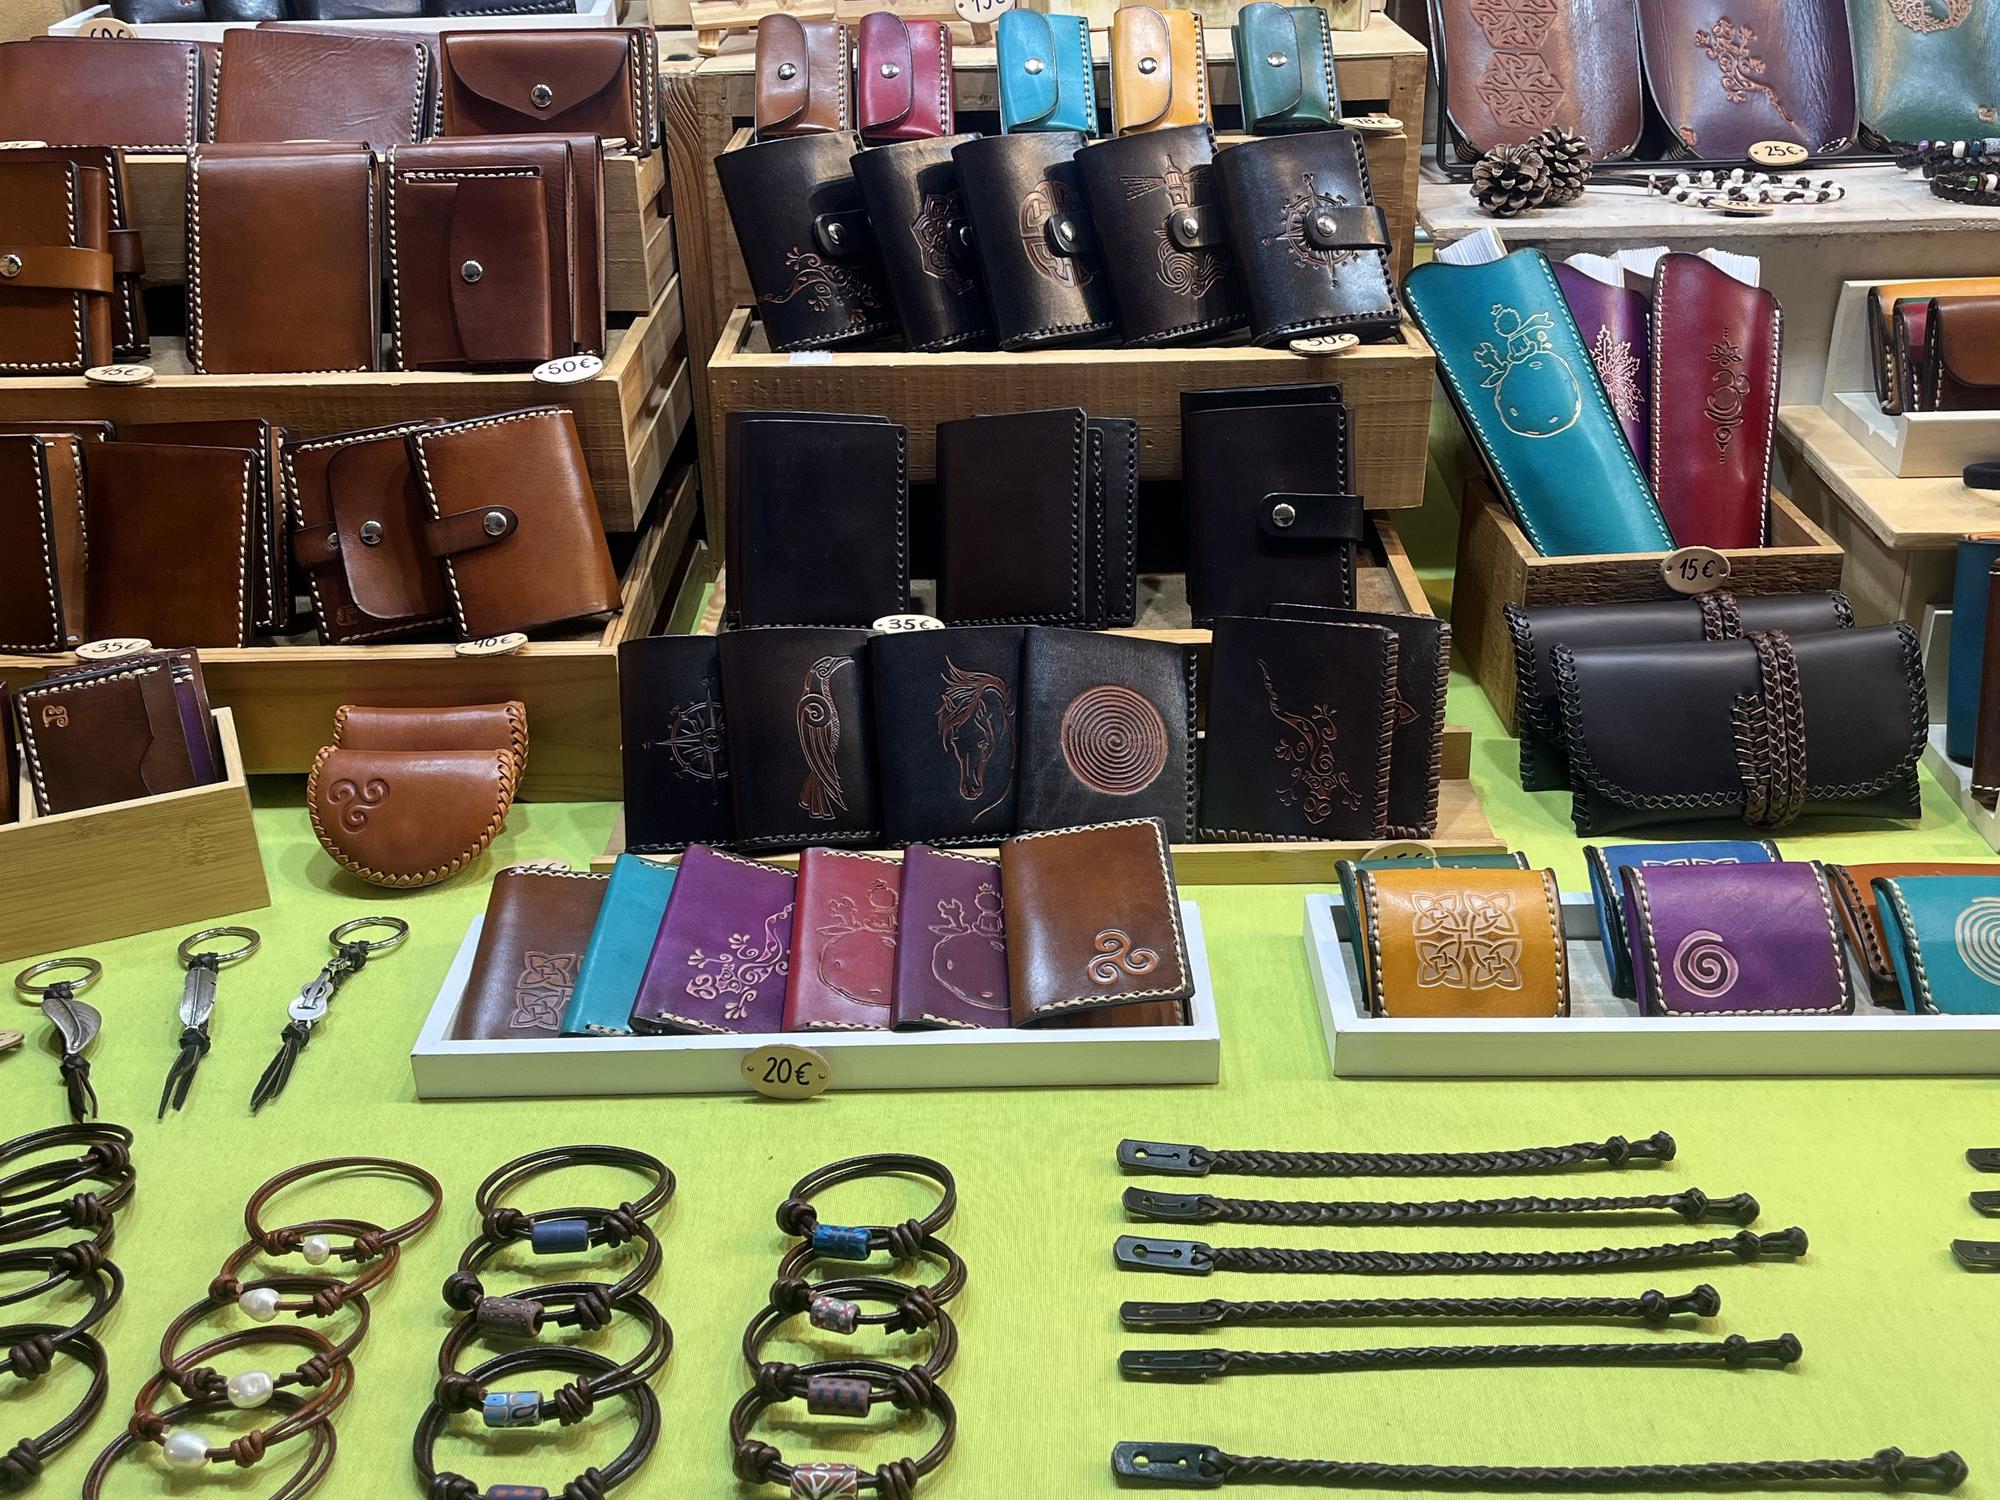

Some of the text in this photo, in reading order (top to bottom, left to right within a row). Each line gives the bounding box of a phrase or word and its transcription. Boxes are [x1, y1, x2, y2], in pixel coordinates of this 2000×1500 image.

[1764, 145, 1798, 157] 25€
[101, 366, 141, 376] 45€
[548, 358, 590, 375] 50€
[1679, 558, 1715, 581] 15€
[888, 618, 929, 631] 35€
[91, 641, 139, 653] 35€
[762, 1057, 812, 1086] 20€
